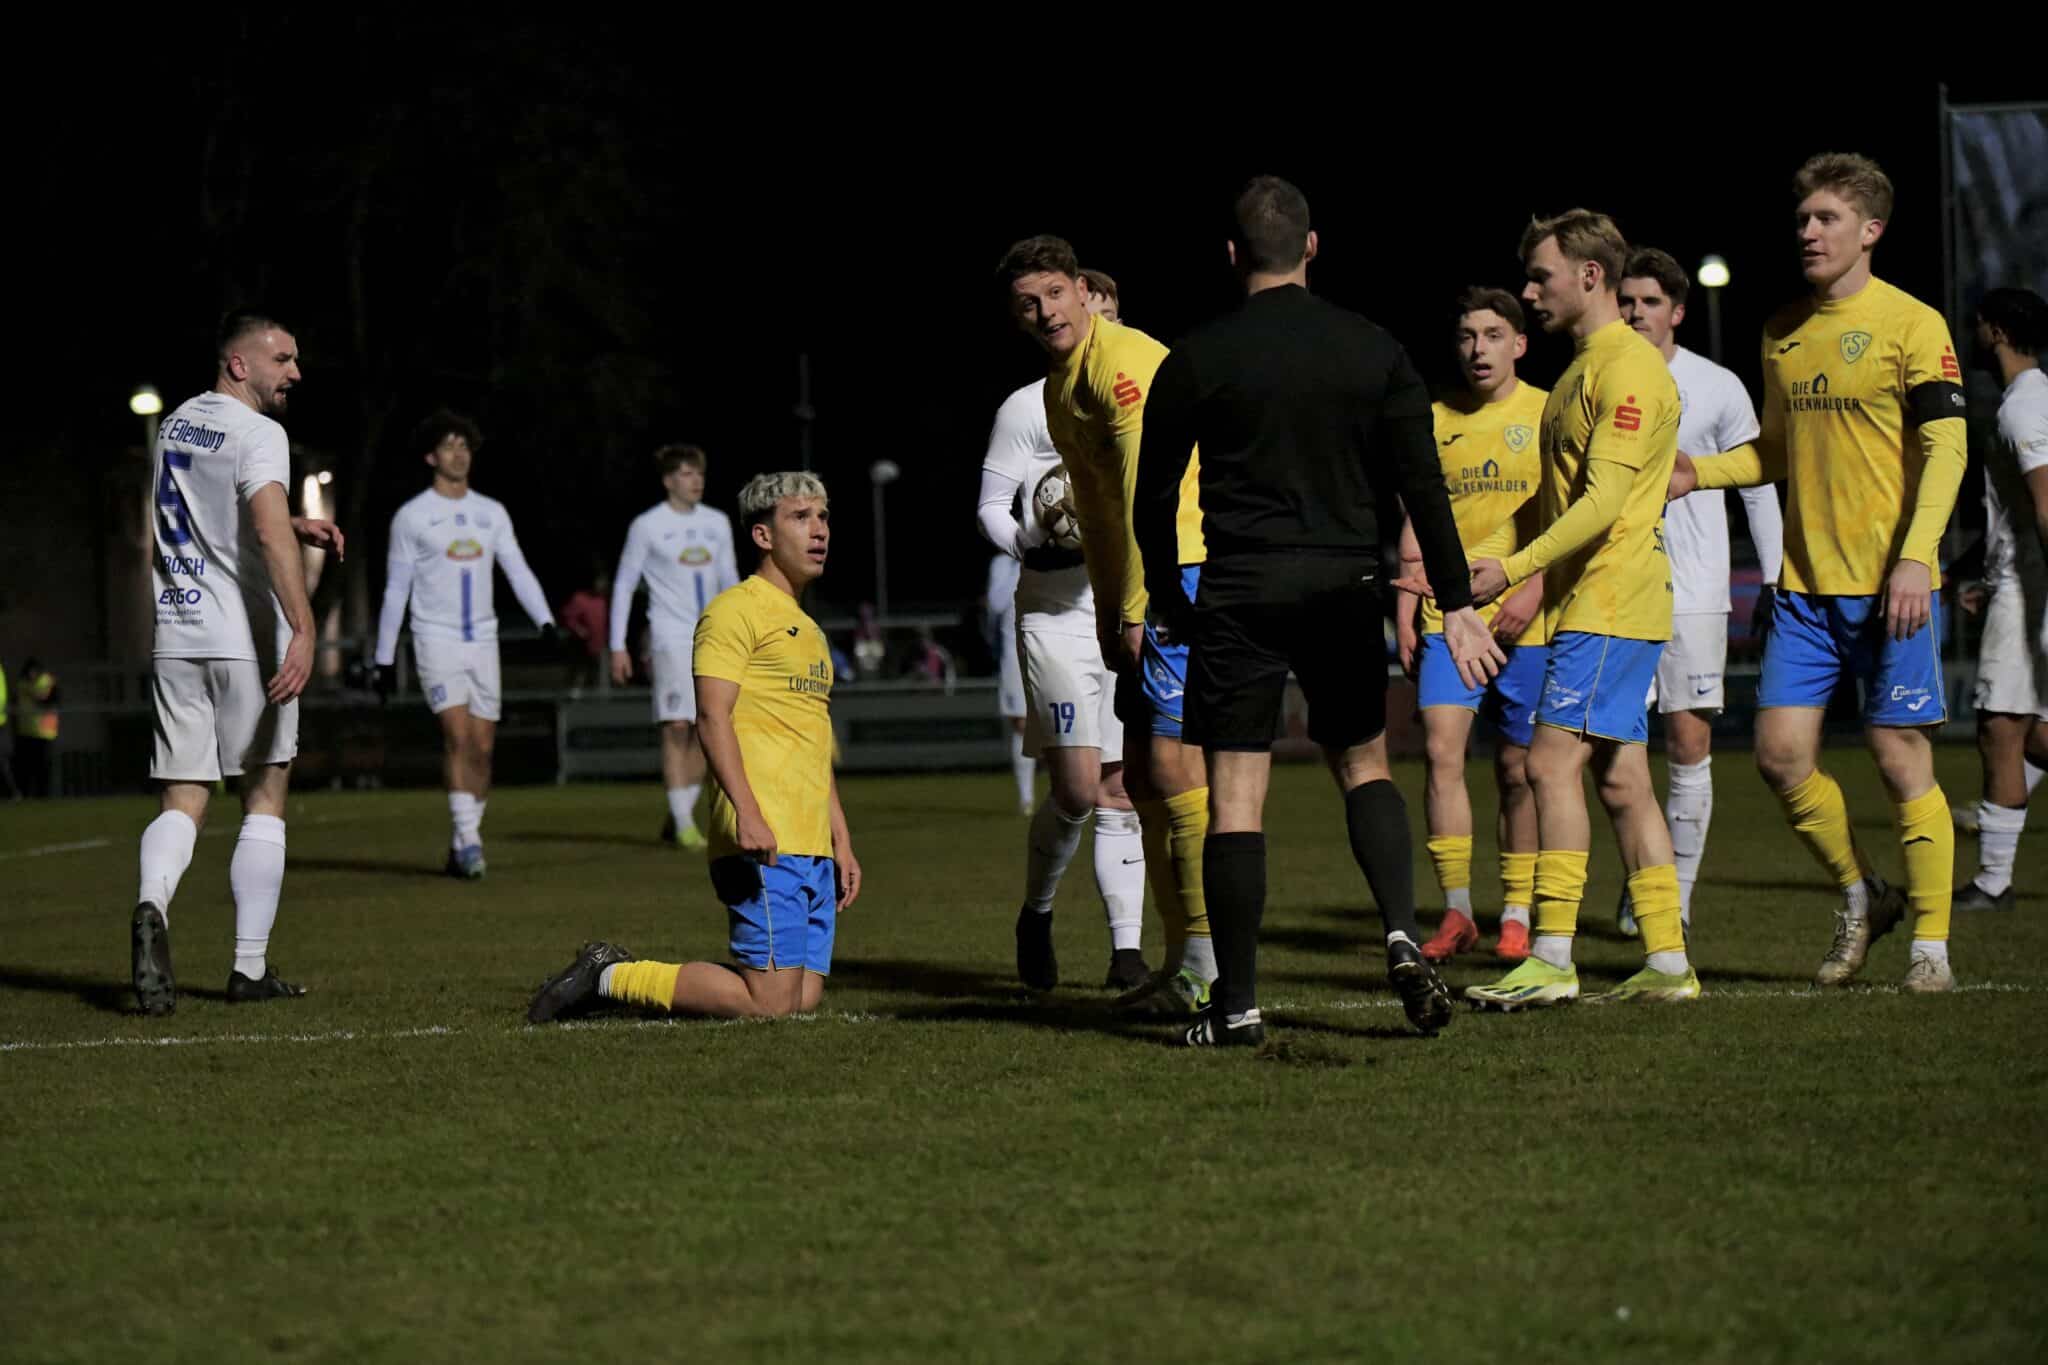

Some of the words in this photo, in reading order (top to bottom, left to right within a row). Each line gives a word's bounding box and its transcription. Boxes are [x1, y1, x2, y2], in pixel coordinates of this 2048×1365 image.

[1791, 381, 1809, 395] DIE
[1783, 396, 1861, 411] KENWALDER
[167, 418, 226, 453] Eilenburg
[1462, 466, 1481, 479] DIE
[158, 588, 202, 606] ERGO
[1048, 702, 1075, 734] 19
